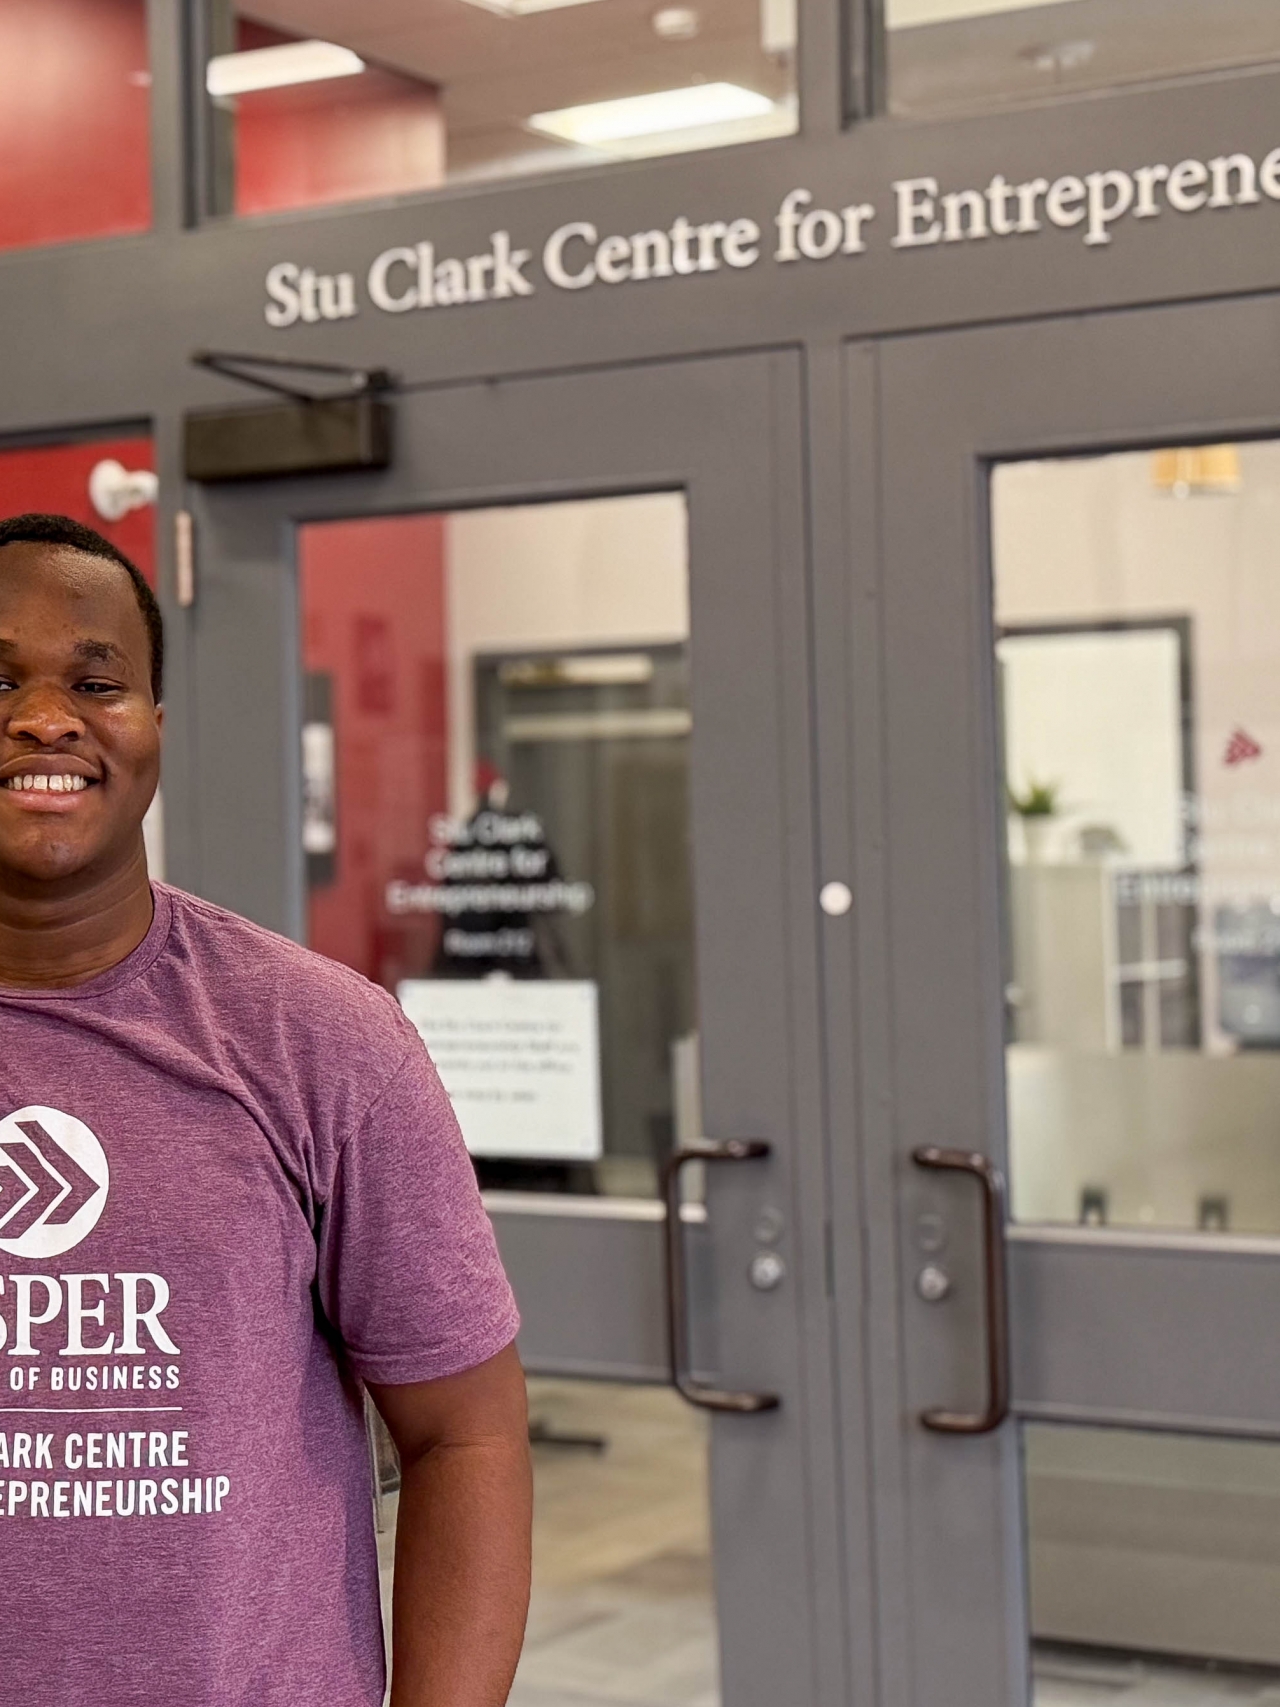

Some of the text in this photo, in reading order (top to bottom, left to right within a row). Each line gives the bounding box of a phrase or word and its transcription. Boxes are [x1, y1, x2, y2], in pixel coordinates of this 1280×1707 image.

[265, 262, 358, 327] Stu
[367, 230, 534, 313] Clark
[543, 216, 760, 290] Centre
[773, 189, 875, 262] for
[474, 814, 544, 843] Clark
[427, 847, 549, 877] Centre for
[387, 883, 592, 914] Entrepreneurship
[9, 1365, 40, 1391] OF
[50, 1365, 180, 1391] BUSINESS
[64, 1431, 189, 1470] CENTRE
